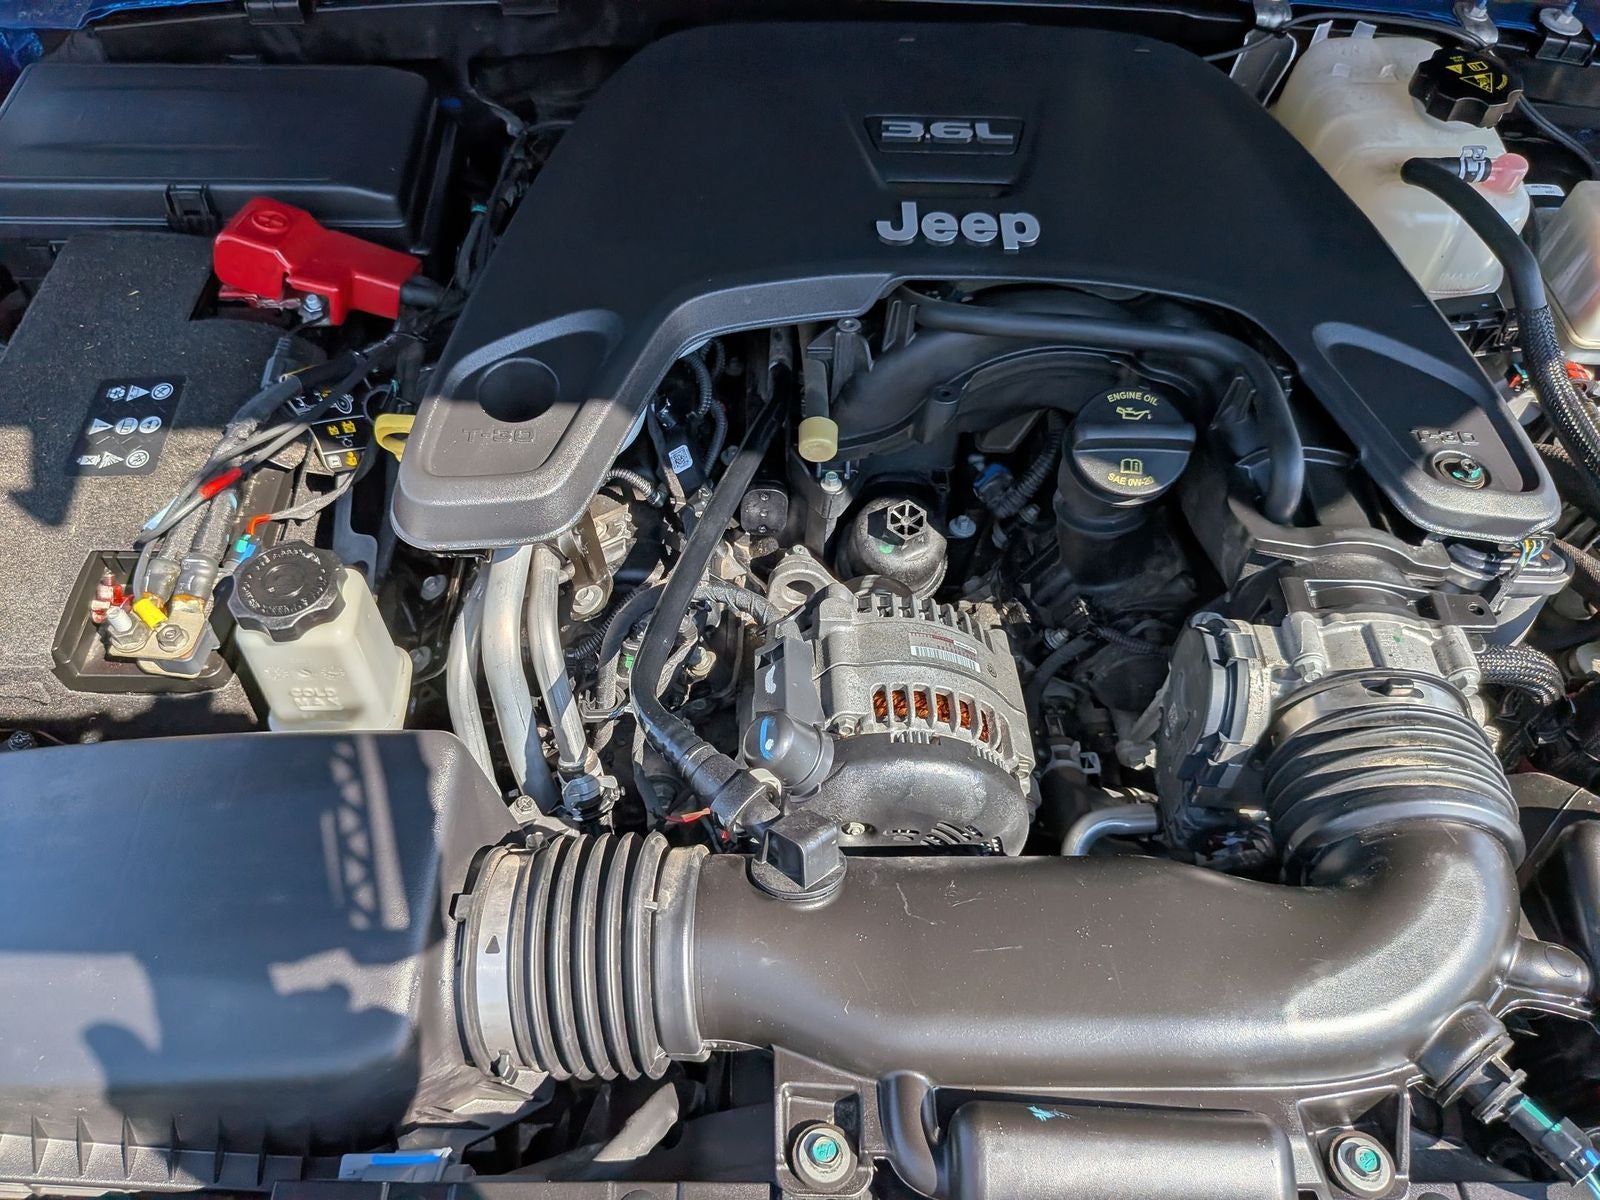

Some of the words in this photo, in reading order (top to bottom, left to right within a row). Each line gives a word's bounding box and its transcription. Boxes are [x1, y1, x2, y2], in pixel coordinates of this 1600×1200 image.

[881, 120, 1014, 144] 3.6L
[875, 201, 1041, 253] Jeep
[1107, 391, 1142, 403] ENGINE
[1143, 394, 1160, 406] OIL
[1107, 472, 1127, 486] SAE
[1127, 475, 1155, 487] 0W-20
[289, 687, 337, 697] COLD
